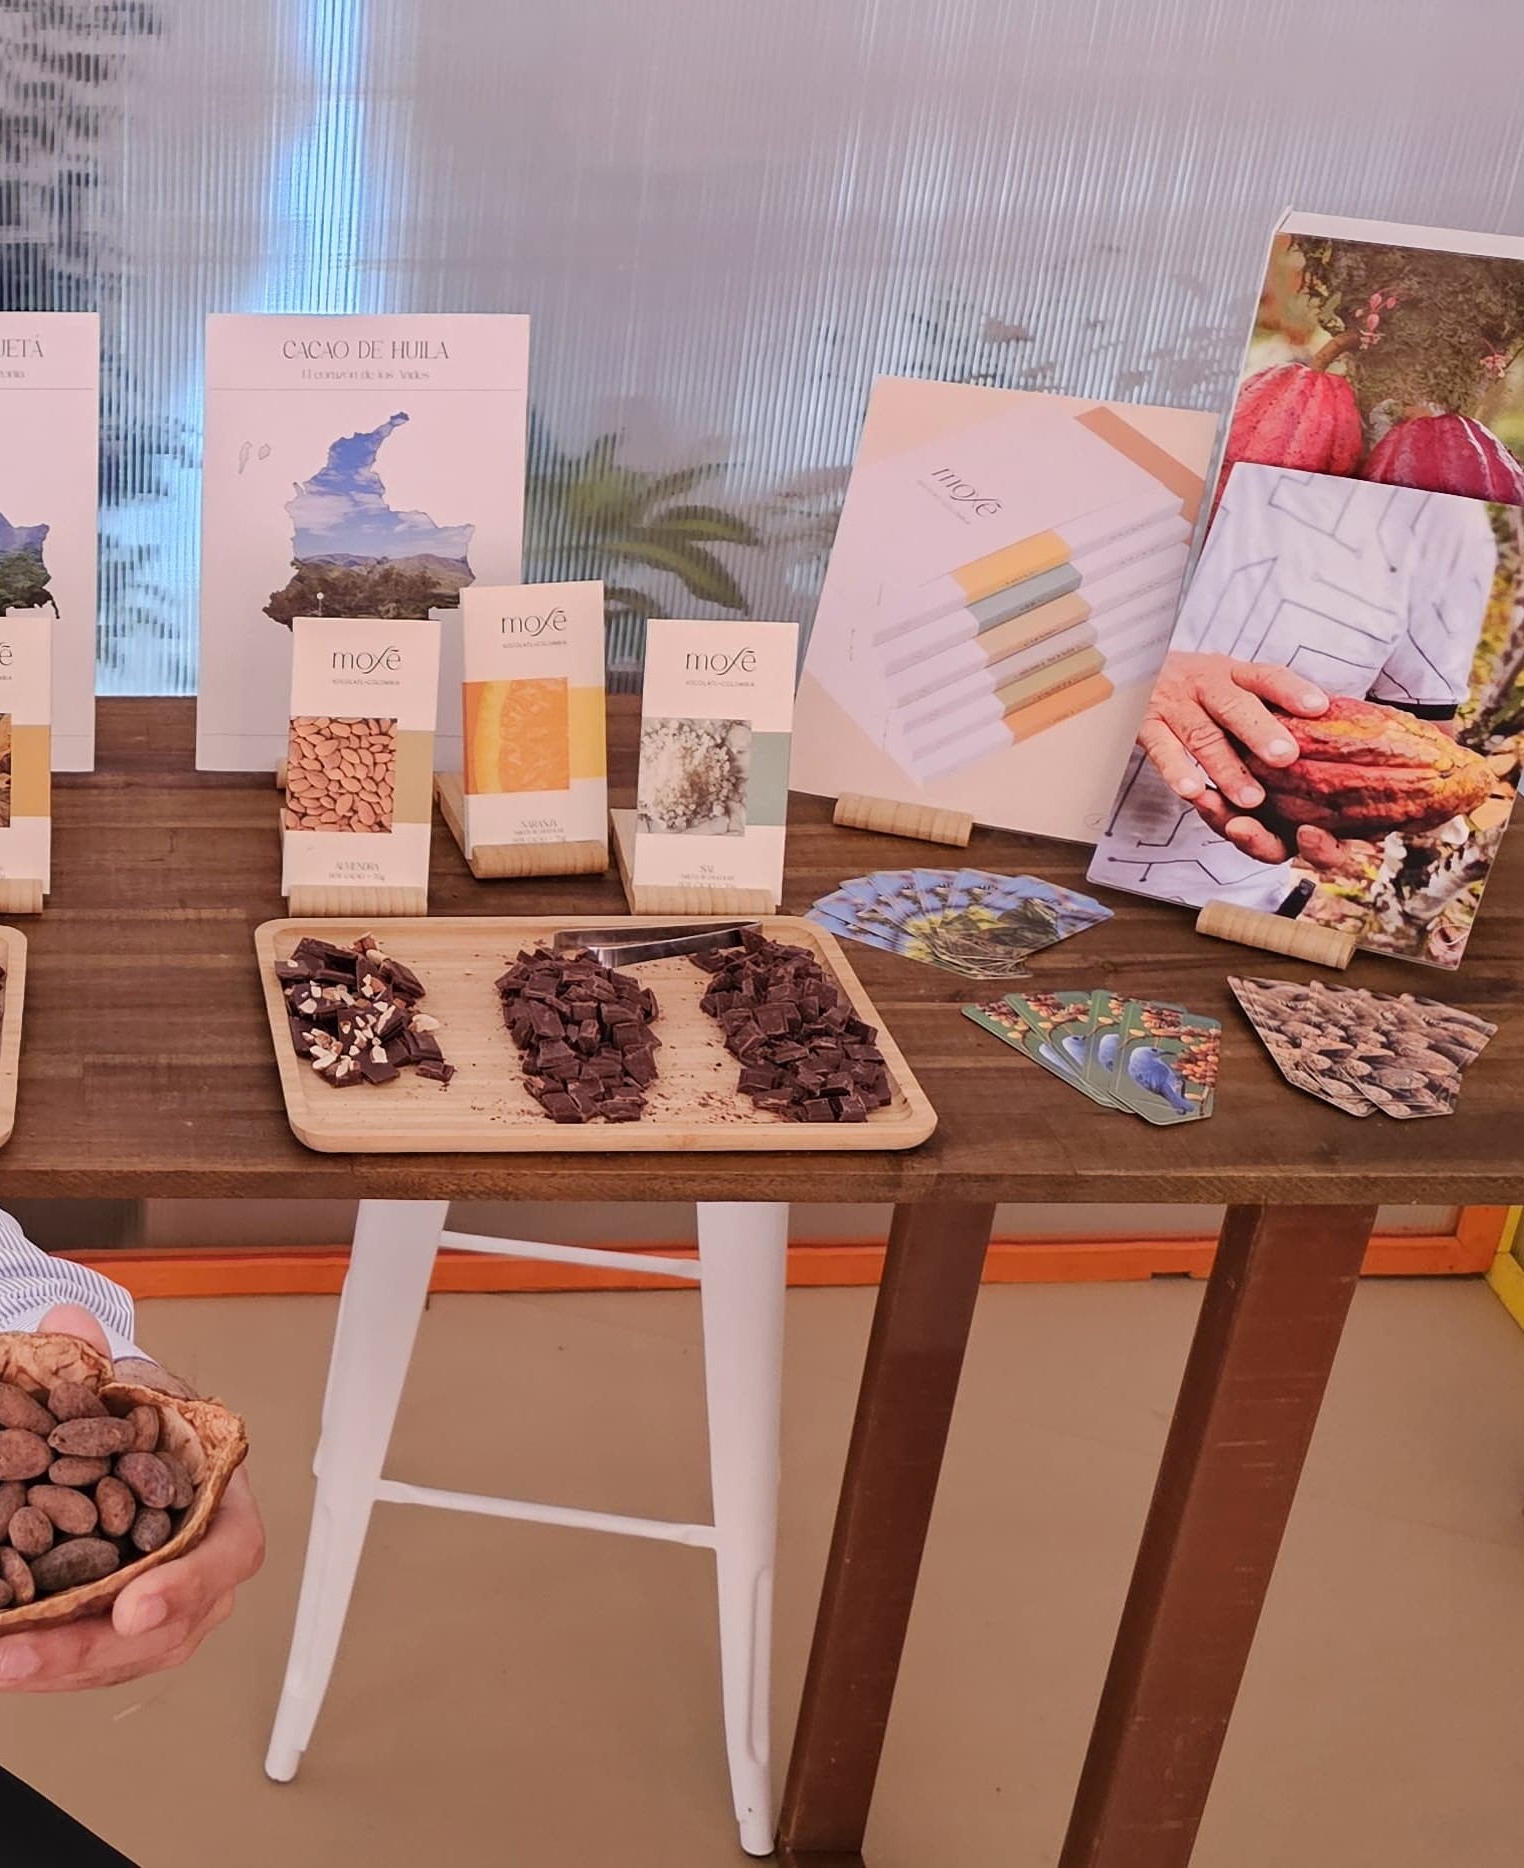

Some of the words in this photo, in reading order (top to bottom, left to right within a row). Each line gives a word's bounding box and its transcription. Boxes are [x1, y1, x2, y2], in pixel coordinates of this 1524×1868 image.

[282, 340, 349, 359] CACAO
[359, 340, 383, 359] DE
[391, 340, 449, 359] HUILA
